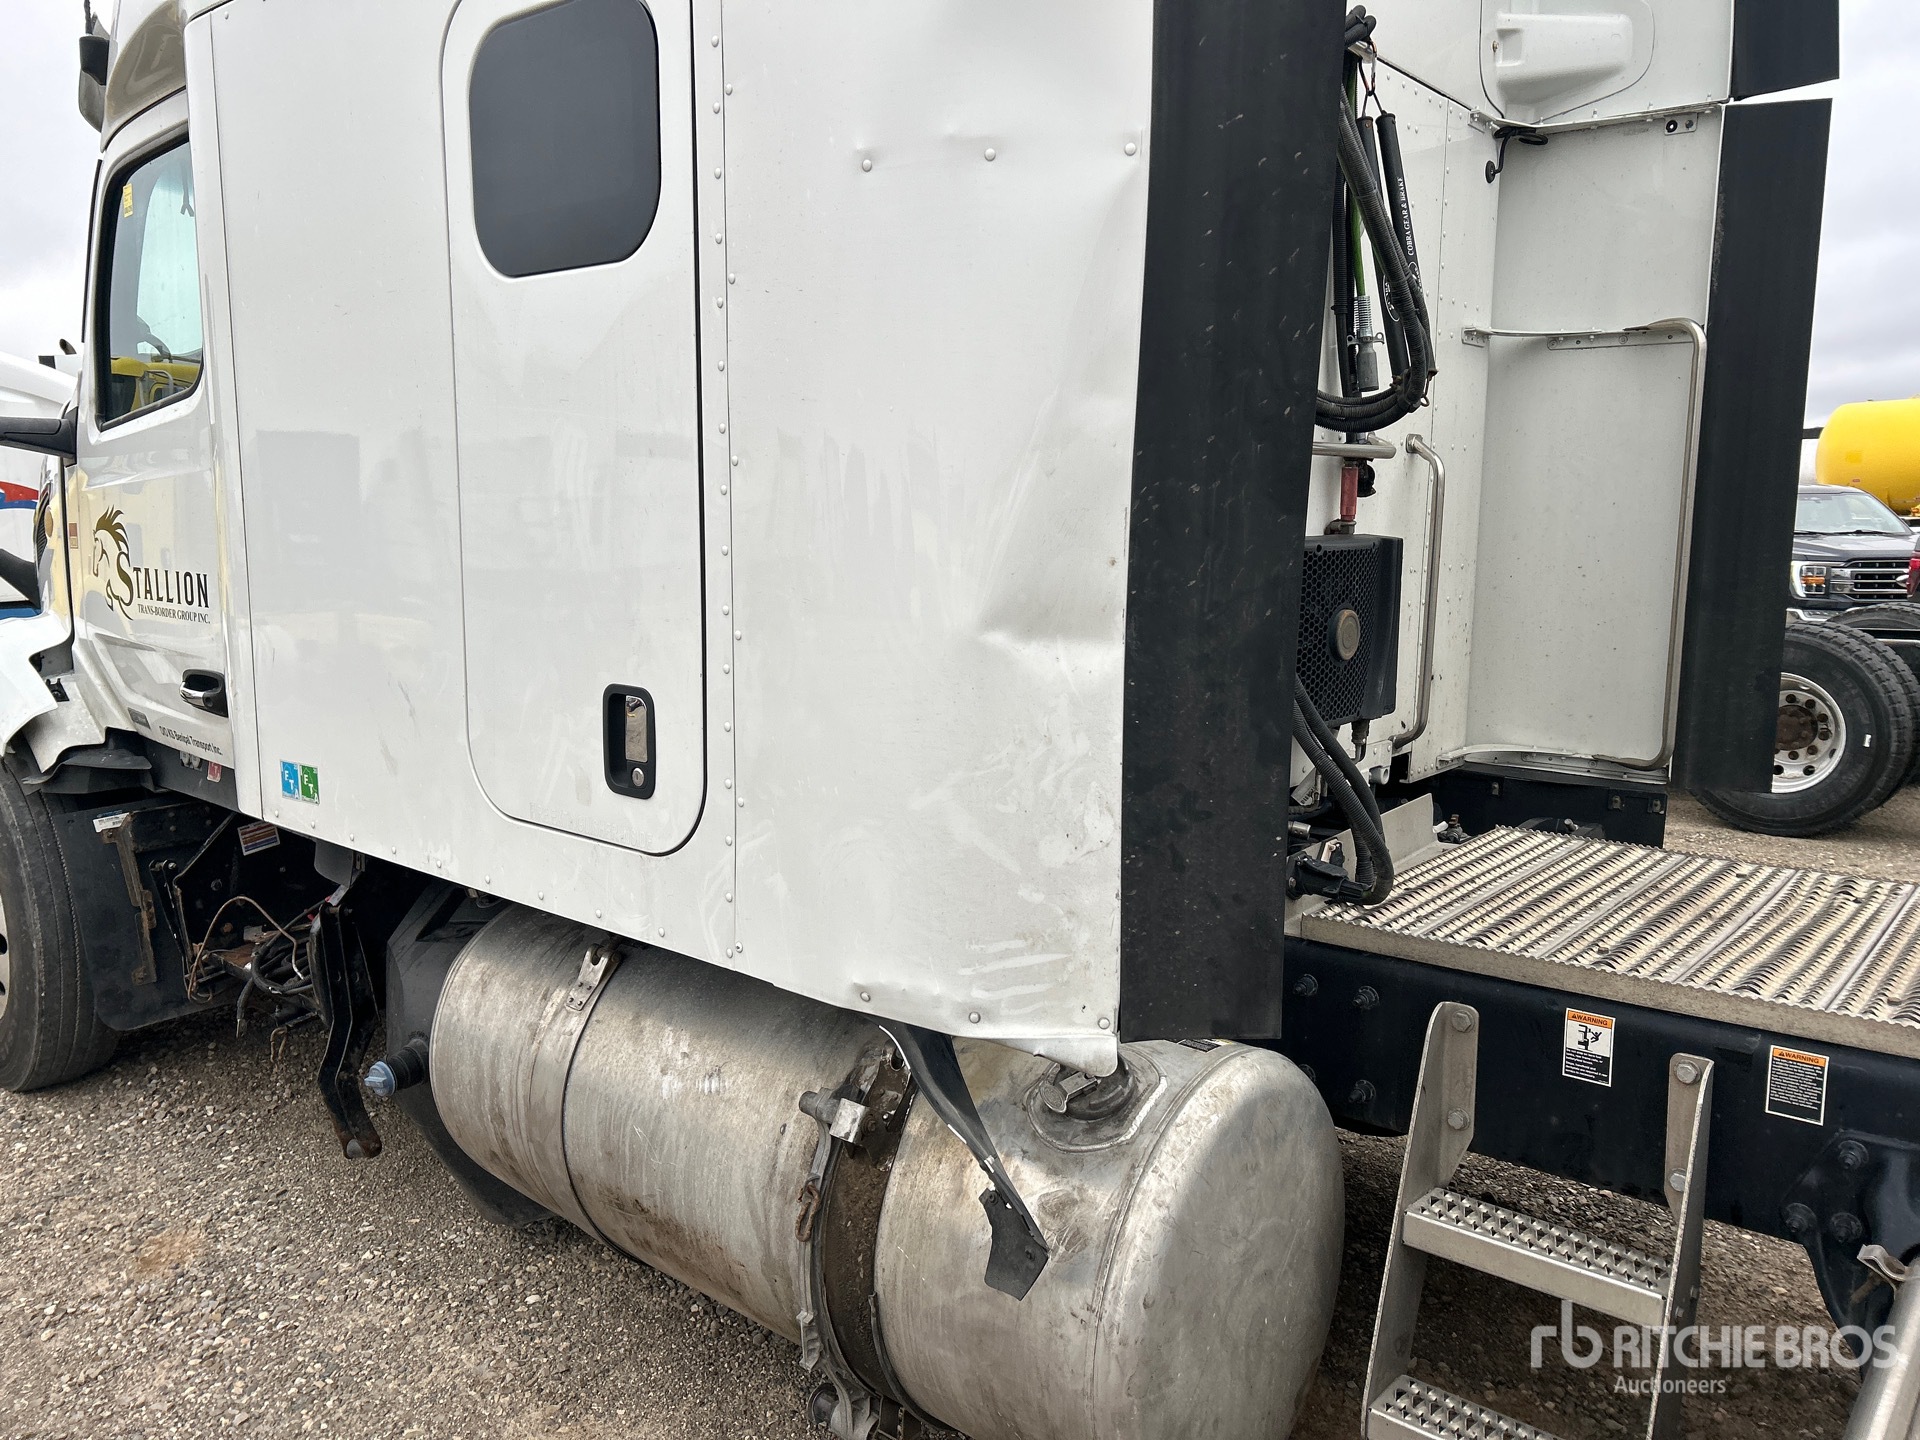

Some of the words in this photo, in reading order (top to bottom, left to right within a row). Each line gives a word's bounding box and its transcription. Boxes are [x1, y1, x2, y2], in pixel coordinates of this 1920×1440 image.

[1402, 209, 1411, 230] GEAR
[1406, 232, 1415, 256] COBRA
[117, 551, 210, 608] STALLION
[177, 609, 198, 622] GROUP
[198, 613, 211, 624] INC.
[1576, 1013, 1608, 1026] WARNING
[1784, 1051, 1819, 1064] WARNING
